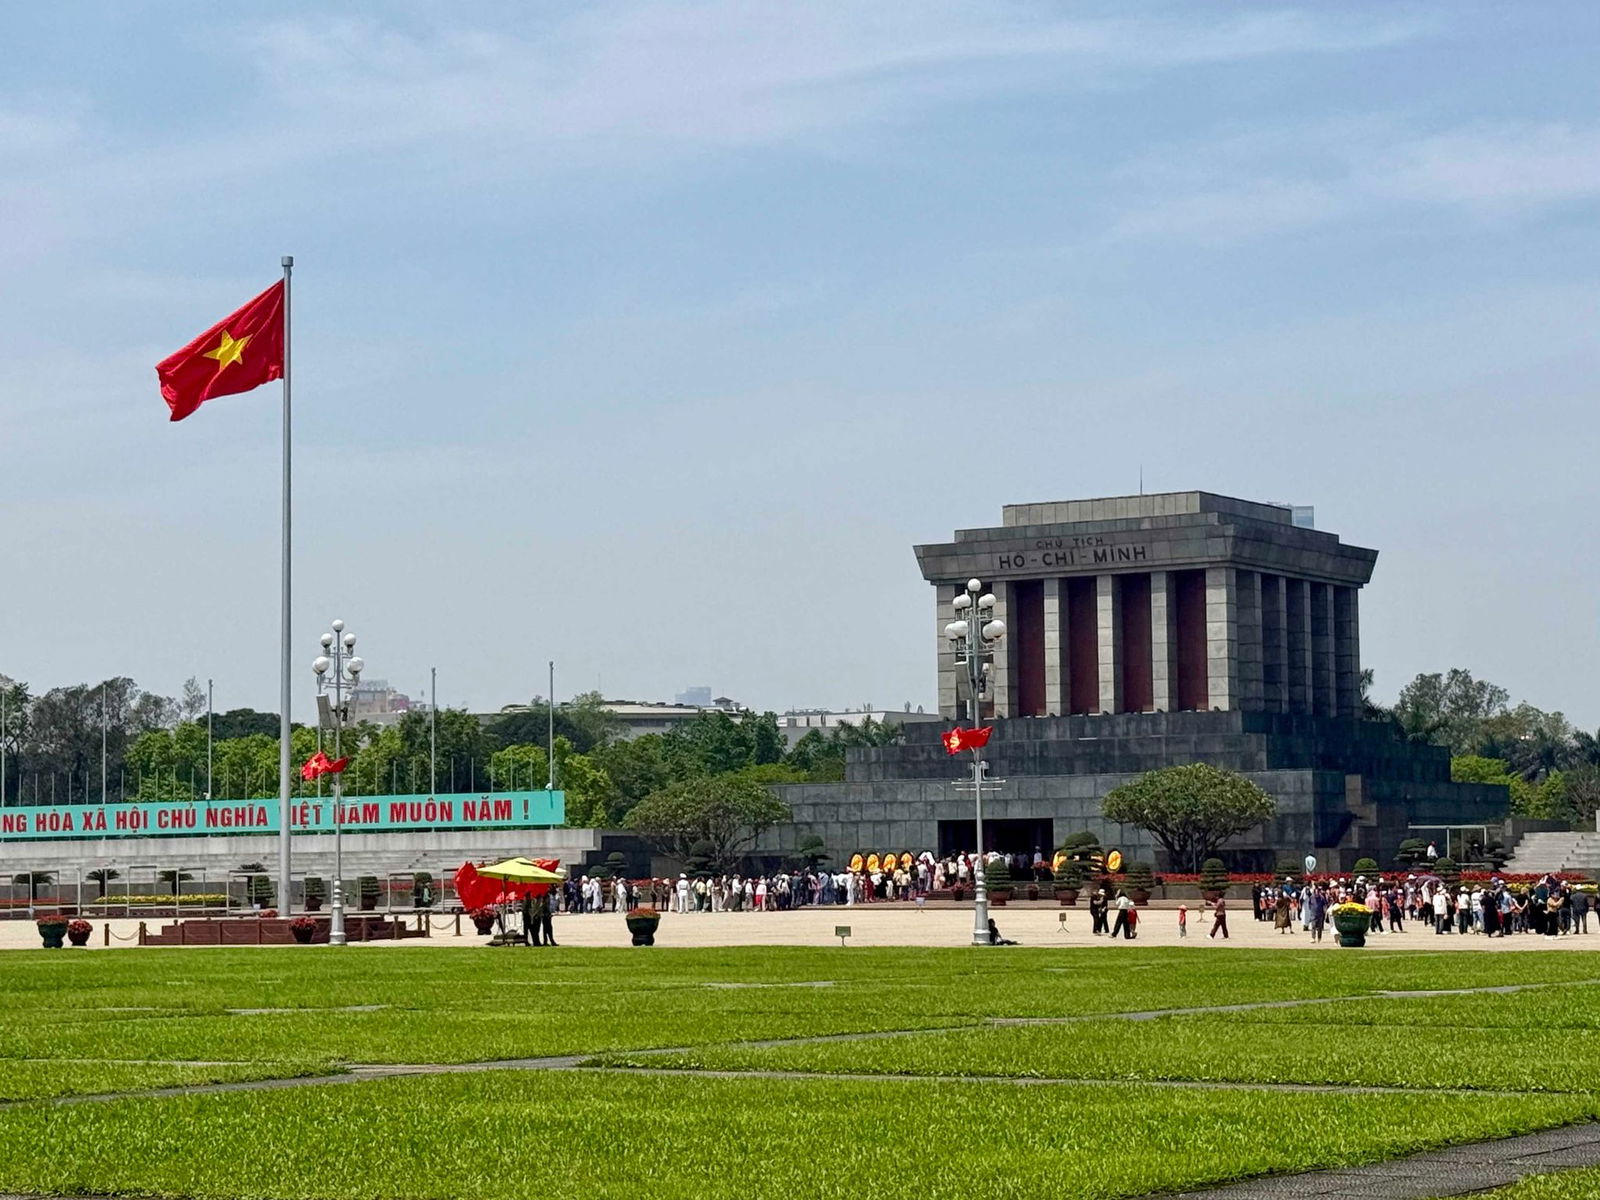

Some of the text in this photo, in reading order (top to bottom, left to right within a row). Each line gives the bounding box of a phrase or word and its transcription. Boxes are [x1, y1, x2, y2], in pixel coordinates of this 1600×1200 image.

[36, 808, 74, 832] HÒA
[82, 807, 107, 831] XÃ
[116, 805, 148, 833] HỘI
[158, 802, 197, 829] CHỦ
[206, 803, 268, 828] NGHĨA
[279, 801, 323, 829] IỆT
[333, 803, 380, 825] NAM
[390, 797, 453, 823] MUÔN
[463, 795, 512, 822] NĂM
